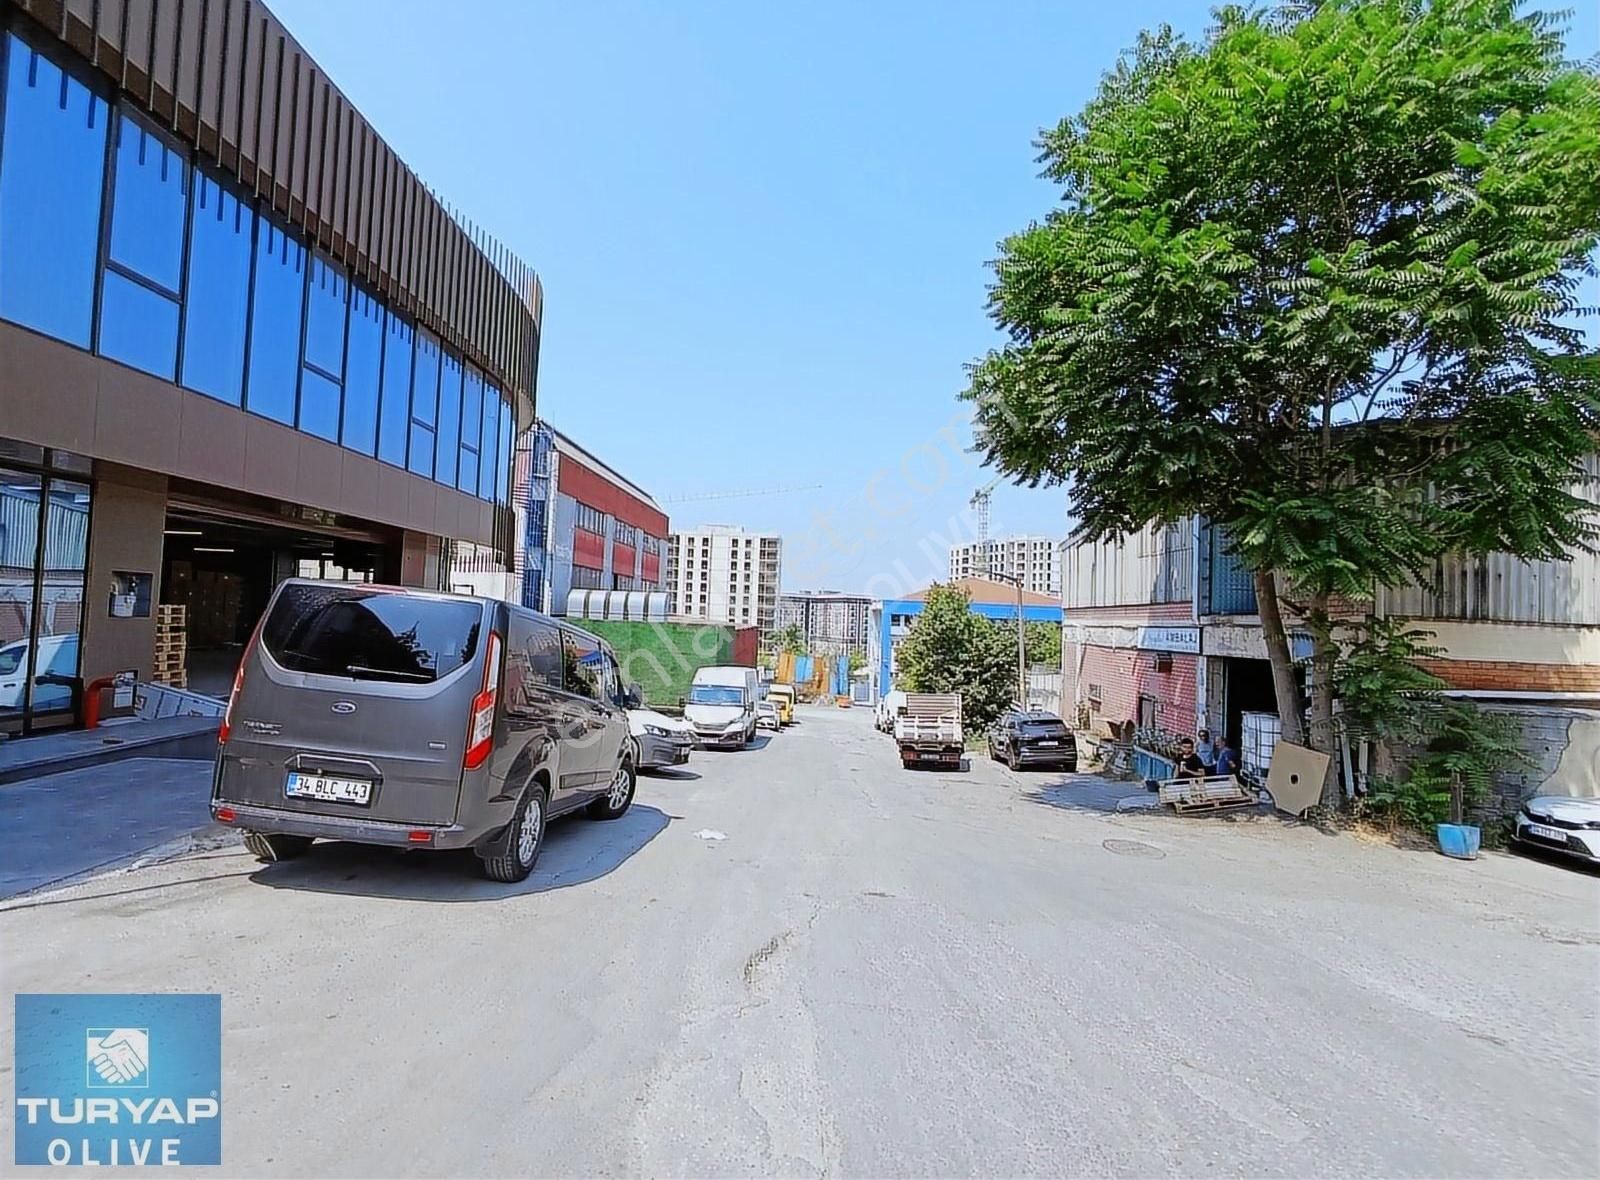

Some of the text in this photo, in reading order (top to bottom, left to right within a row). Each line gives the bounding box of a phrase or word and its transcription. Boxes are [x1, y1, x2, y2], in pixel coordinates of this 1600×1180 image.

[297, 777, 368, 798] 34 BLC 443
